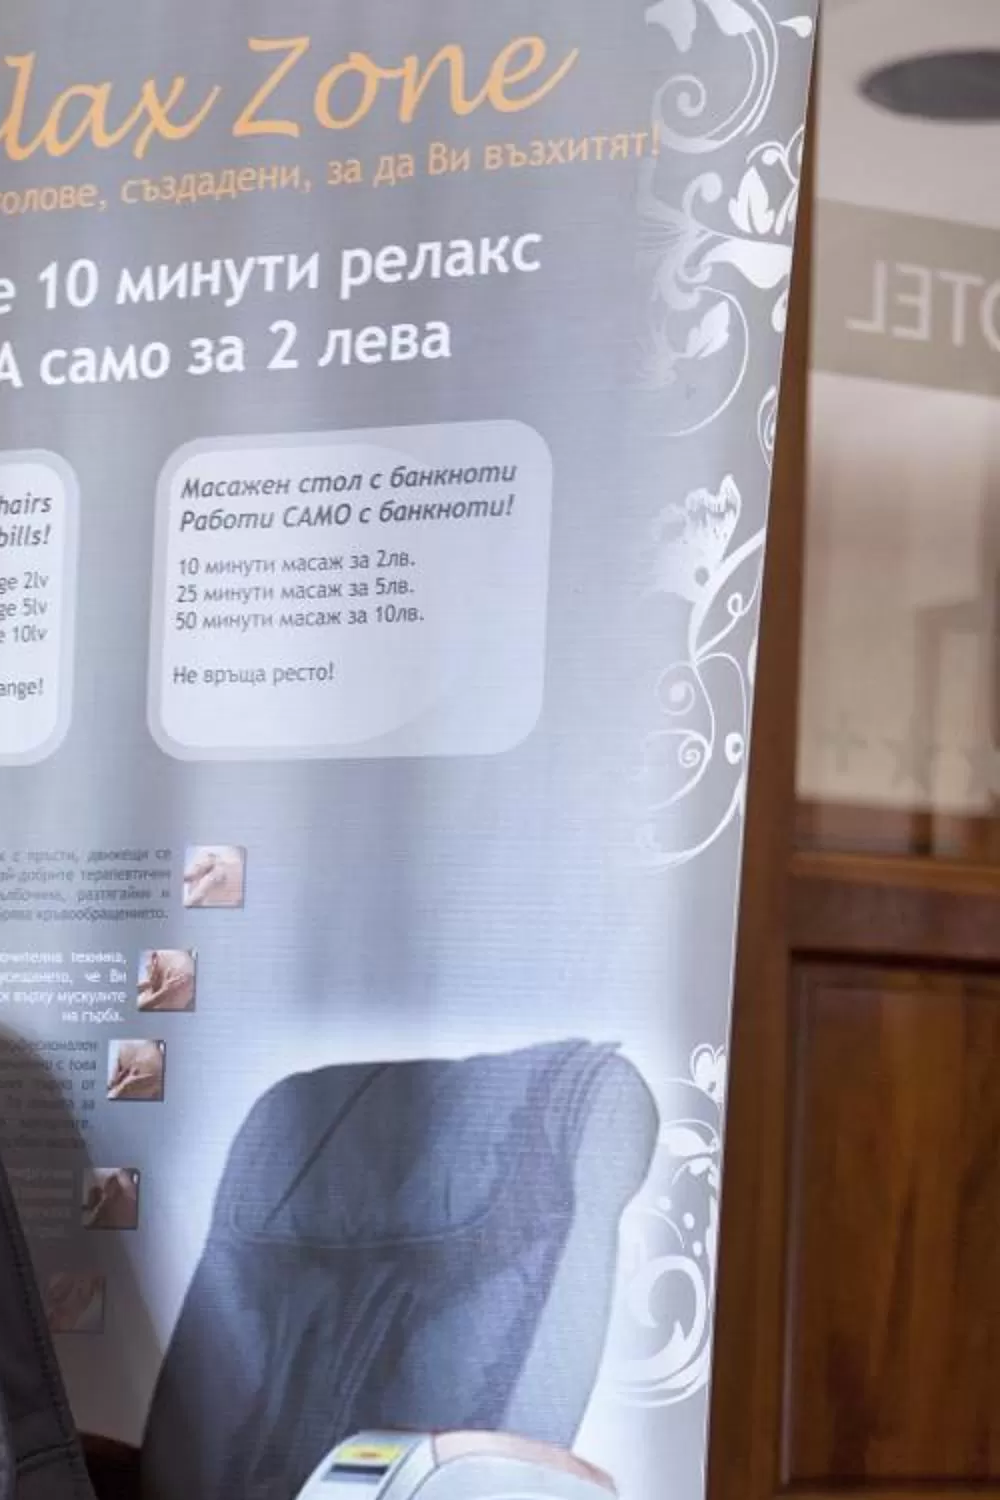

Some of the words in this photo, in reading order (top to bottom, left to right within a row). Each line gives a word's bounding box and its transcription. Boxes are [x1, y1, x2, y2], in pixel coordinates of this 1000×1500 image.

[231, 35, 579, 138] Zone
[120, 164, 312, 206] създадени,
[327, 156, 362, 186] за
[373, 150, 414, 188] да
[428, 142, 471, 173] Ви
[484, 123, 662, 170] възхитят!
[39, 258, 99, 310] 10
[116, 249, 319, 306] минути
[340, 231, 542, 301] релакс
[39, 342, 170, 386] само
[187, 333, 245, 377] за
[268, 320, 298, 369] 2
[318, 320, 451, 368] лева
[180, 477, 291, 500] Масажен
[299, 472, 362, 494] стол
[369, 472, 383, 490] с
[390, 464, 517, 490] банкноти
[179, 508, 275, 533] Работи
[282, 503, 351, 529] САМО
[358, 505, 372, 524] с
[378, 494, 515, 523] банкноти!
[178, 556, 200, 576] 10
[204, 555, 276, 578] минути
[281, 552, 344, 573] масаж
[348, 552, 370, 570] за
[376, 549, 416, 569] 2лв.
[23, 571, 49, 590] 2lv
[176, 584, 198, 604] 25
[202, 584, 274, 606] минути
[280, 580, 343, 600] масаж
[348, 579, 369, 597] за
[375, 576, 415, 596] 5лв.
[22, 597, 48, 616] 5lv
[175, 611, 197, 631] 50
[202, 611, 274, 634] минути
[279, 607, 342, 627] масаж
[347, 606, 368, 625] за
[375, 603, 425, 624] 10лв.
[12, 624, 48, 644] 10lv
[173, 665, 198, 685] Не
[202, 666, 267, 687] връща
[272, 661, 335, 686] ресто!
